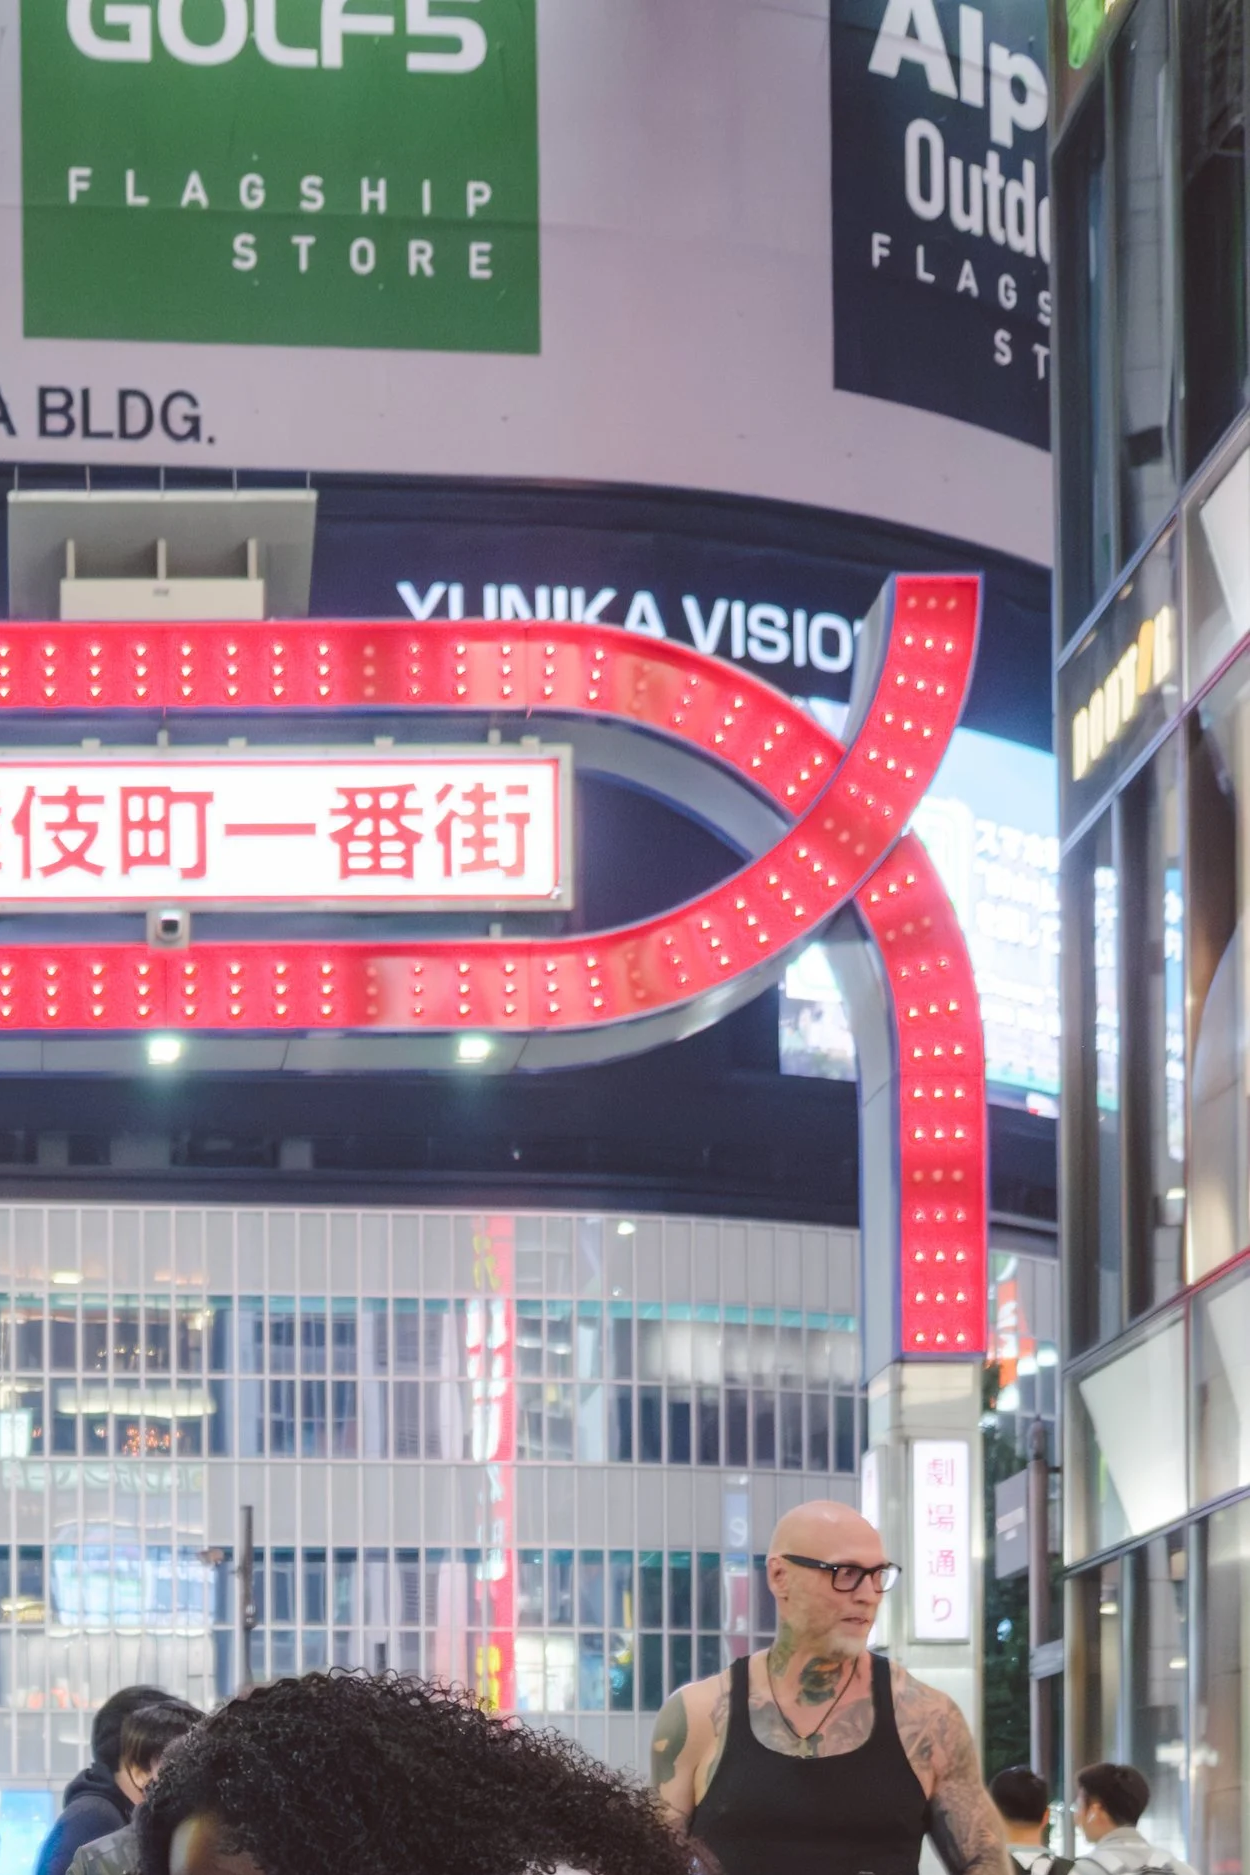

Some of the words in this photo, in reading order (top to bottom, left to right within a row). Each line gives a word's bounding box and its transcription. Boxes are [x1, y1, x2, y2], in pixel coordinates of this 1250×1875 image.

[67, 167, 492, 217] FLAGSHIP
[232, 233, 492, 279] STORE
[37, 386, 215, 444] BLDG.
[681, 595, 863, 672] VISIO
[926, 1458, 956, 1622] 劇場通り
